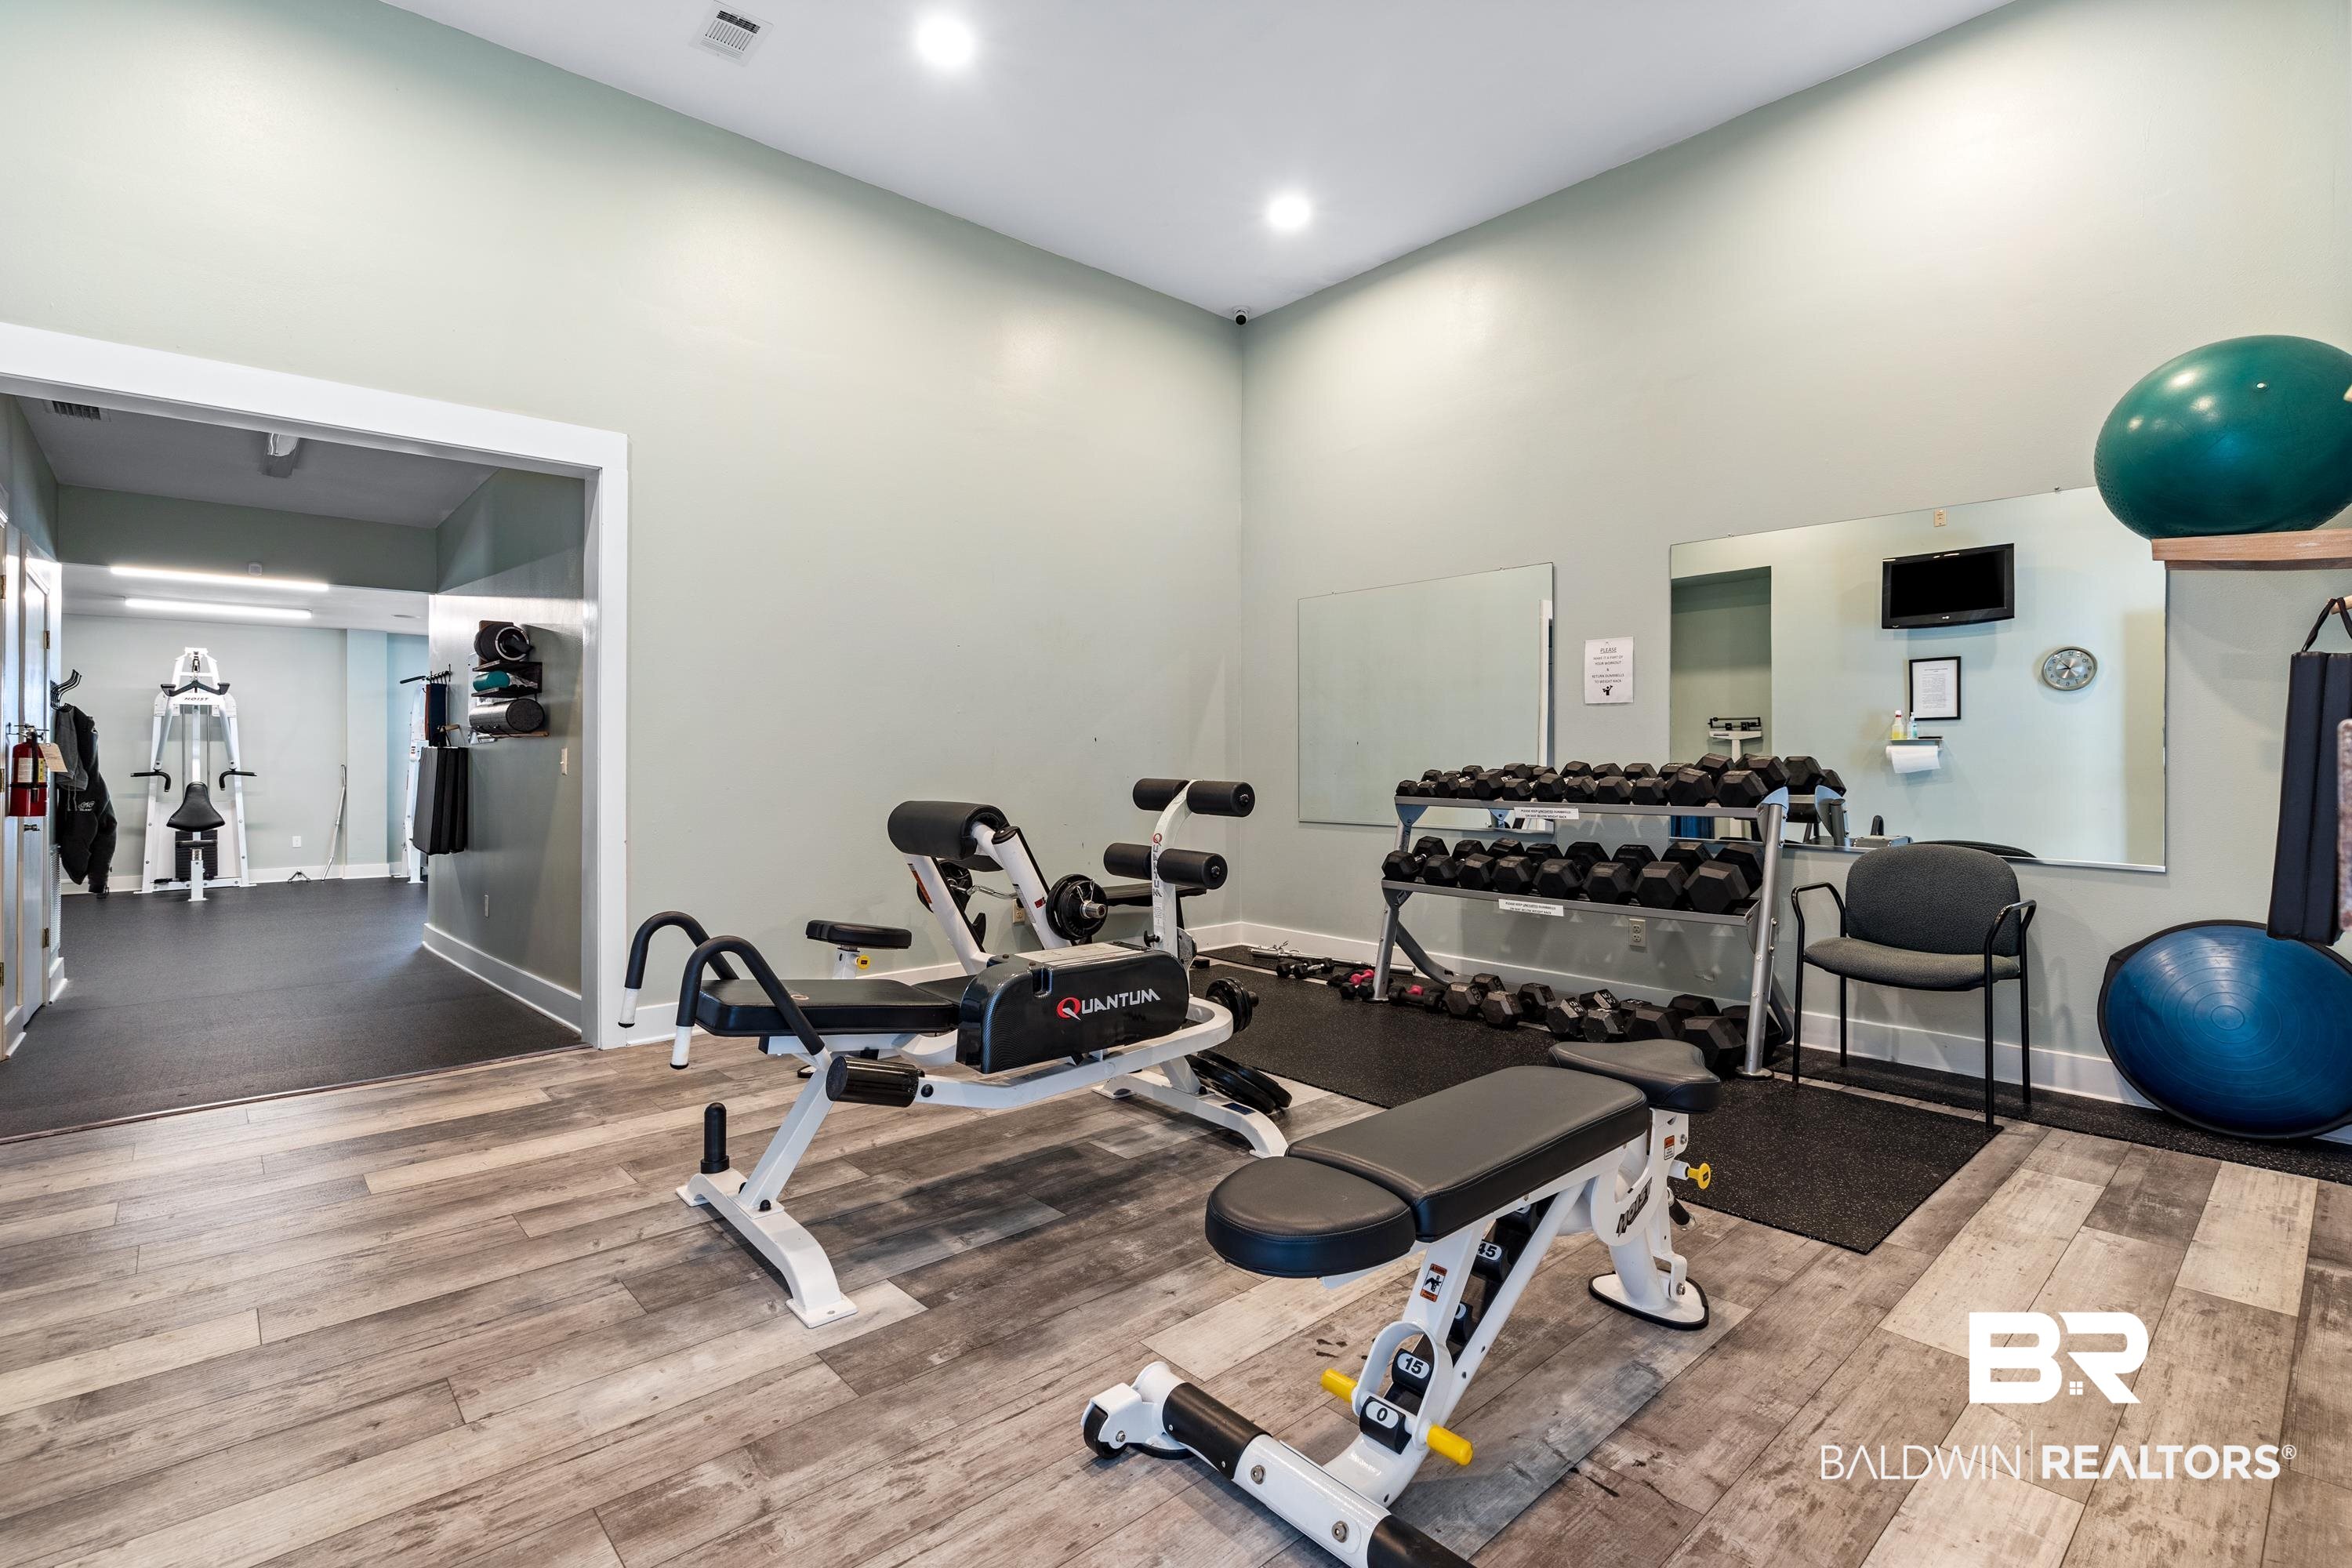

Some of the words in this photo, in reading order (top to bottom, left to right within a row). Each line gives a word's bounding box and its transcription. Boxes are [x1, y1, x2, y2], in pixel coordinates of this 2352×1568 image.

[1057, 989, 1160, 1021] QUANTUM
[1616, 1177, 1652, 1237] HOIST
[1478, 1243, 1497, 1258] 45
[1406, 1357, 1424, 1375] 15
[1377, 1407, 1388, 1421] 0
